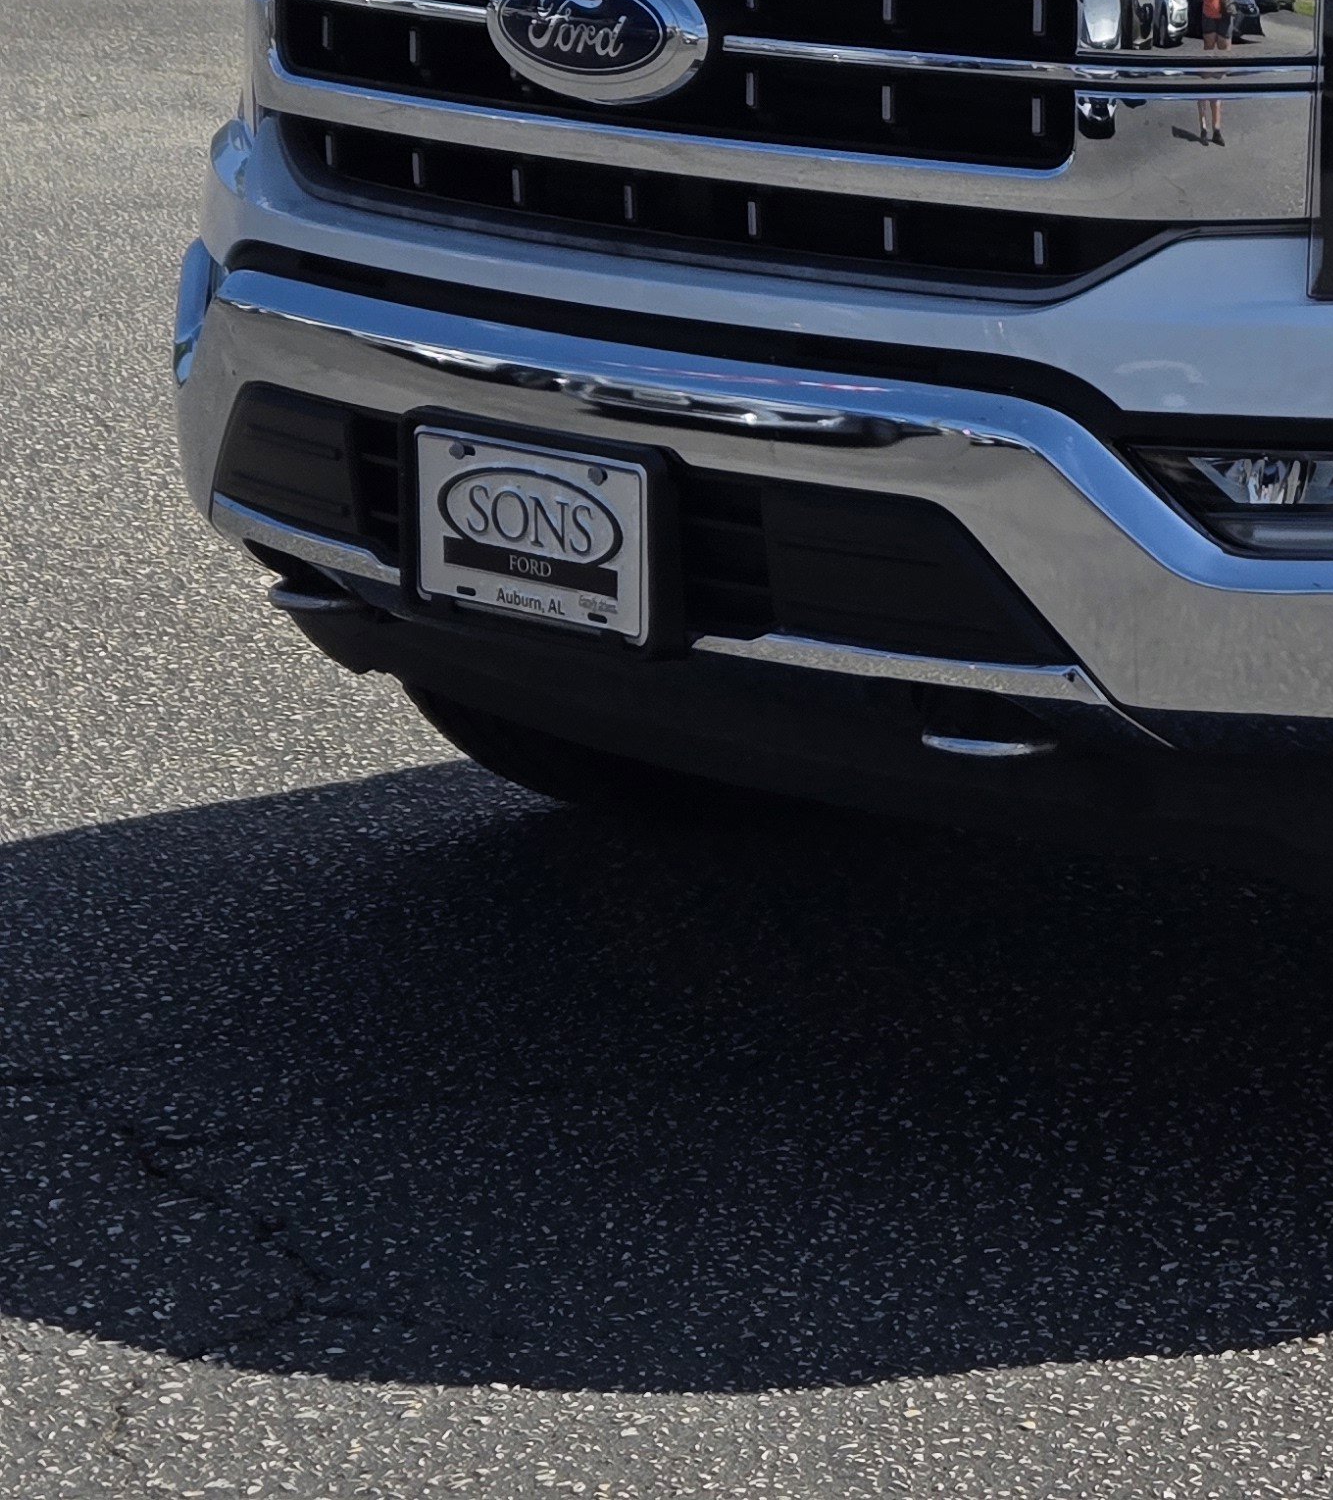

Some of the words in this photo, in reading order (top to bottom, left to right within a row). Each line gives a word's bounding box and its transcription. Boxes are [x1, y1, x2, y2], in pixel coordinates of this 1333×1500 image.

[467, 484, 594, 556] SONS
[508, 554, 552, 578] FORD
[497, 588, 546, 613] Auburn,
[547, 597, 566, 616] AL
